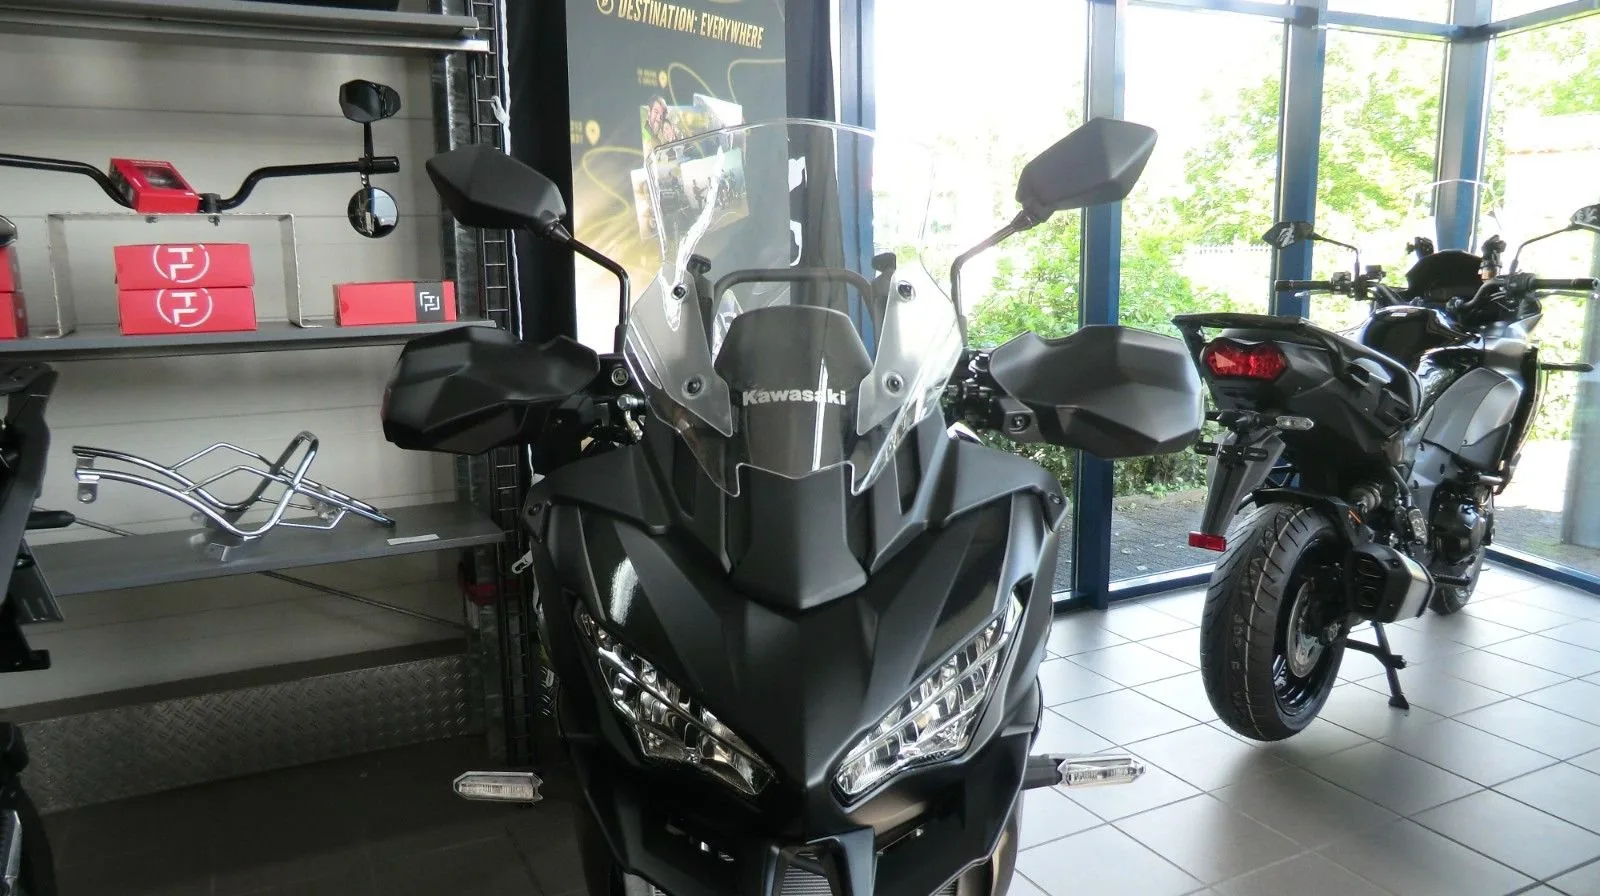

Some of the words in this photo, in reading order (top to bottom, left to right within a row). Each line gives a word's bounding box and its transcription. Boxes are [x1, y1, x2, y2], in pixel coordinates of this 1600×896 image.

[618, 0, 697, 33] DESTINATION:
[700, 12, 764, 48] EVERYWHERE
[743, 388, 846, 405] Kawasaki
